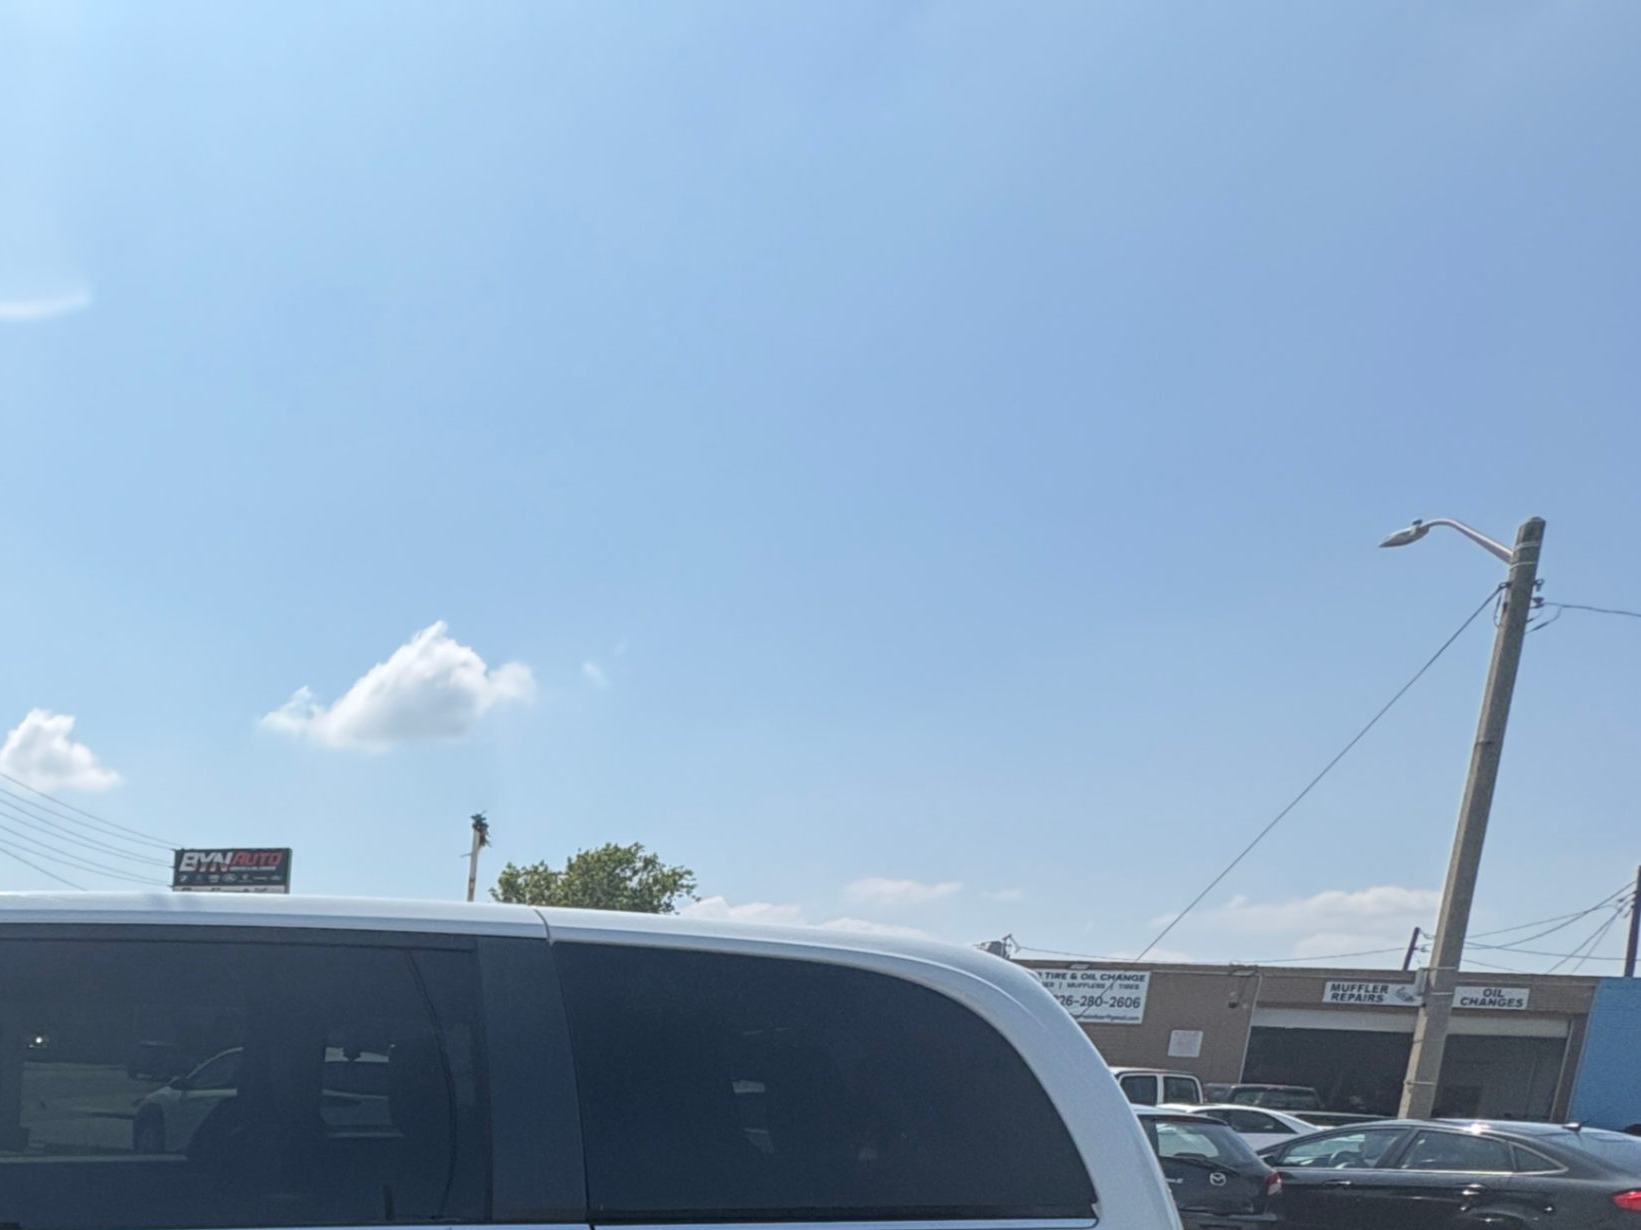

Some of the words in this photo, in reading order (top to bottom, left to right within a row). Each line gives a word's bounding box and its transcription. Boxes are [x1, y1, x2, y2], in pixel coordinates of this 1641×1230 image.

[1045, 972, 1067, 981] TIRE
[1080, 973, 1098, 981] OIL
[1099, 973, 1146, 982] CHANGE
[1330, 983, 1389, 995] MUFFLER
[1482, 987, 1505, 998] OIL
[1331, 992, 1384, 1003] REPAIRS
[1459, 996, 1524, 1008] CHANGES
